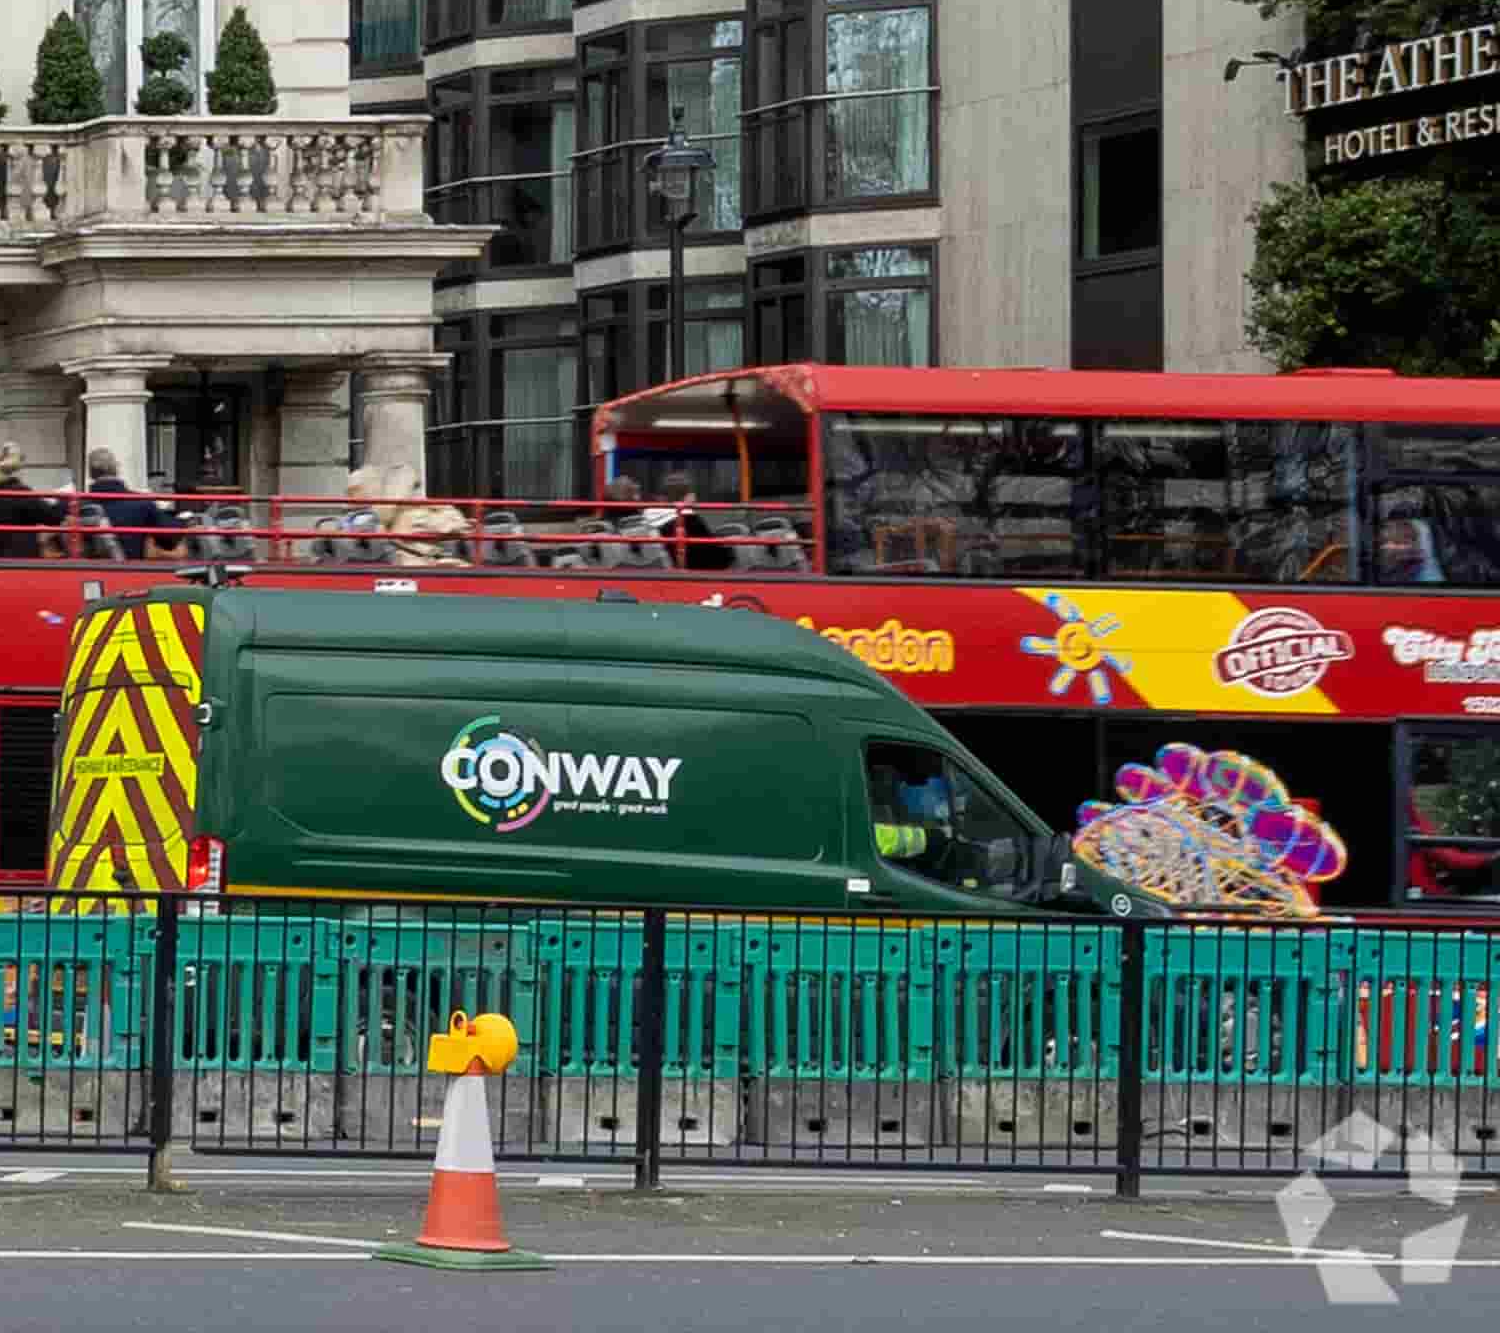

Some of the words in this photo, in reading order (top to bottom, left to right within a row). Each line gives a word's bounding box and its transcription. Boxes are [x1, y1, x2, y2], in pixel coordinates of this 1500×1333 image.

[1276, 52, 1363, 115] THE
[1372, 23, 1500, 97] ATHE
[1324, 121, 1407, 165] HOTEL
[1416, 116, 1438, 147] &
[1226, 635, 1348, 678] OFFICIAL
[441, 747, 683, 800] CONWAY
